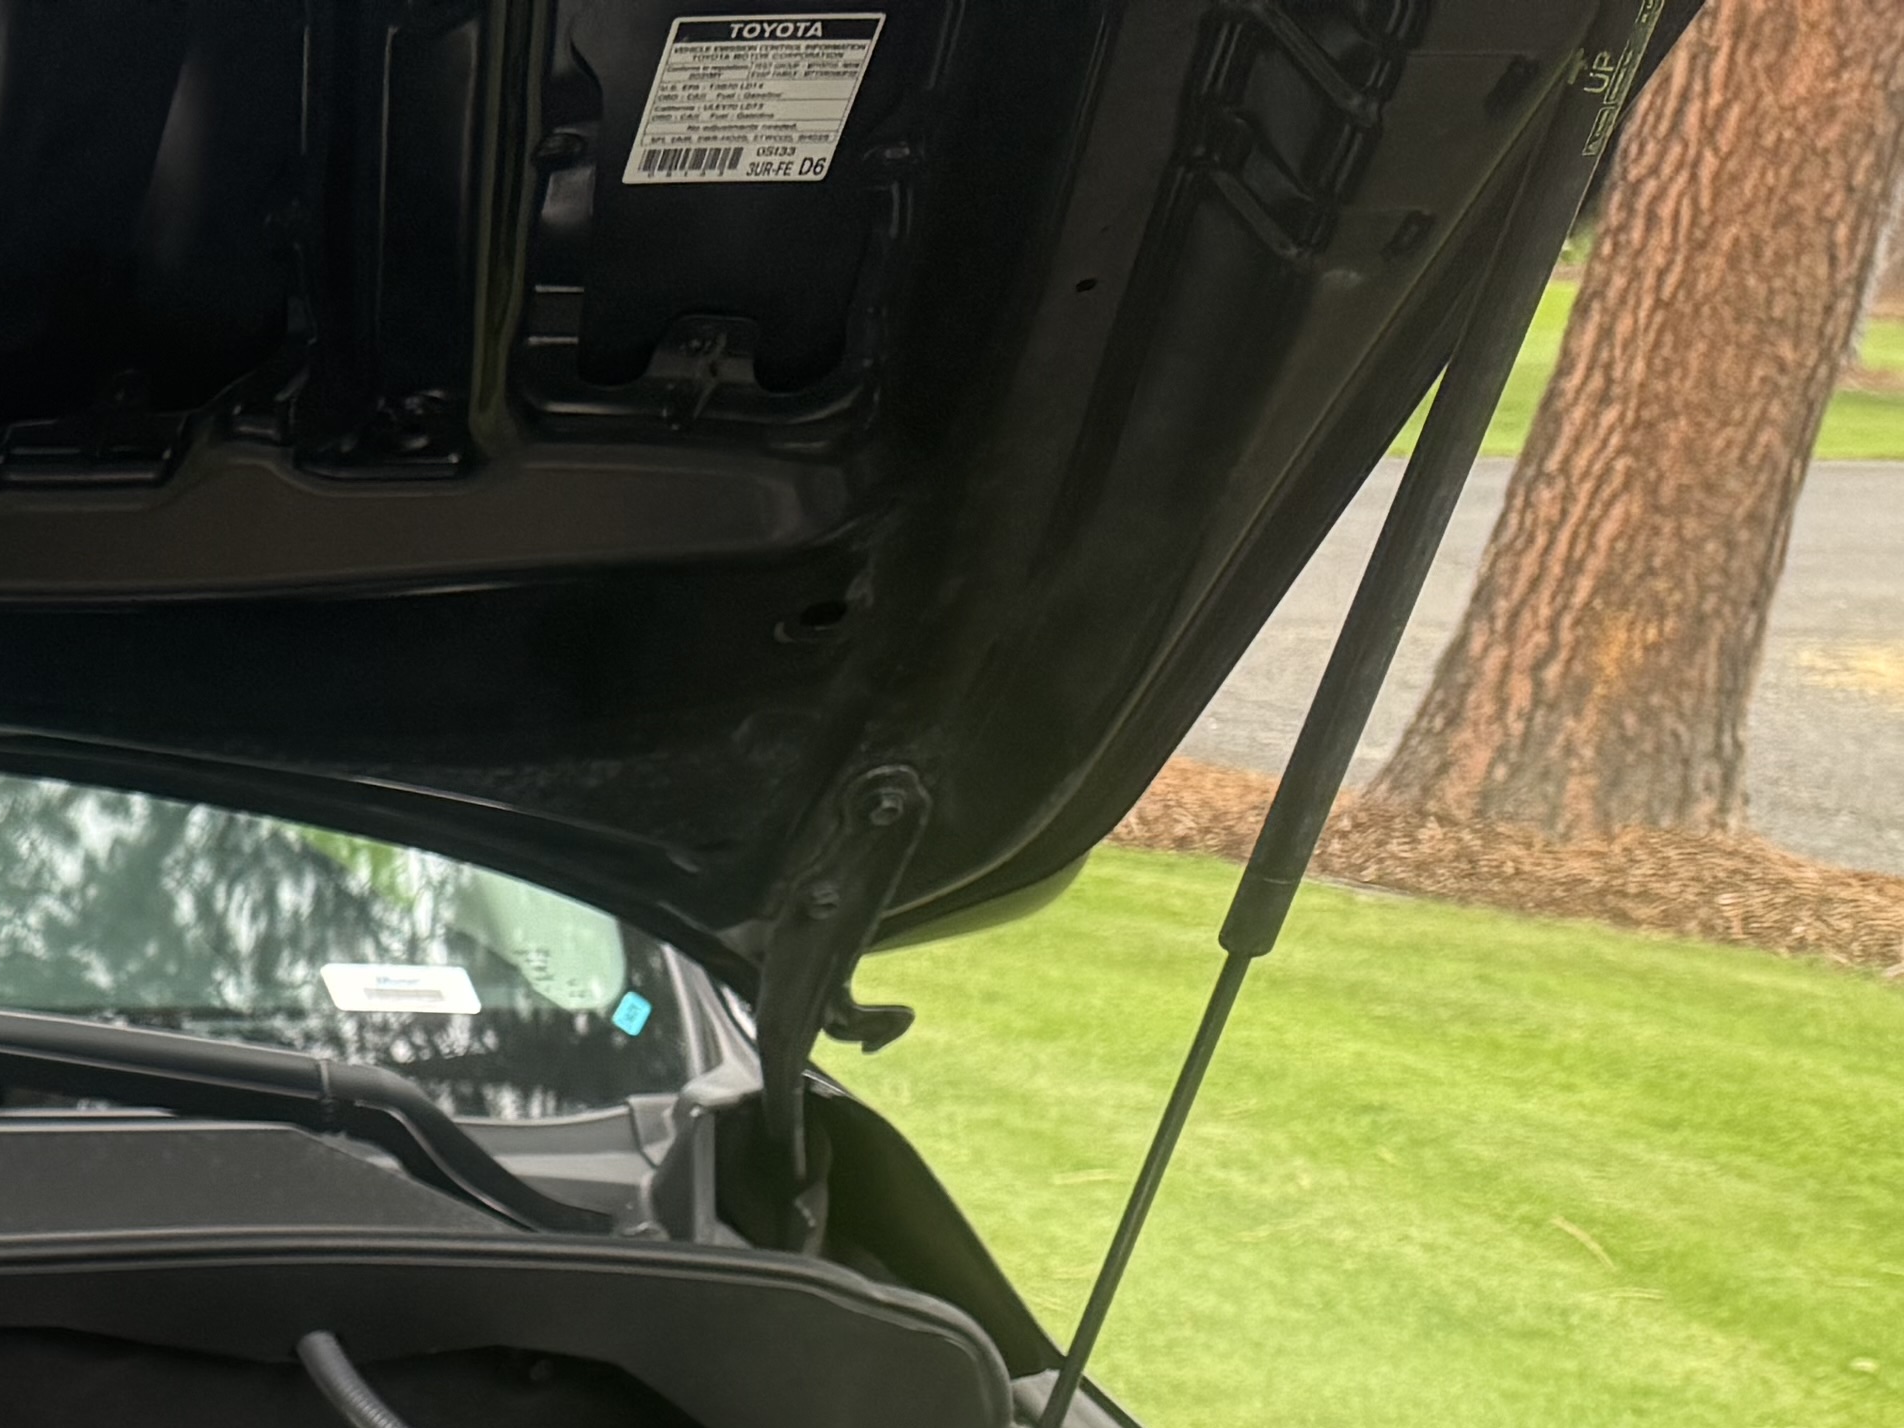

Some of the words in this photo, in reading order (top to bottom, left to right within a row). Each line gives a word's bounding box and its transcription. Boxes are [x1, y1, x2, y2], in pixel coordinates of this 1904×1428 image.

[730, 21, 823, 39] TOYOTA
[746, 161, 794, 177] 3UR-FE
[798, 157, 827, 176] D6
